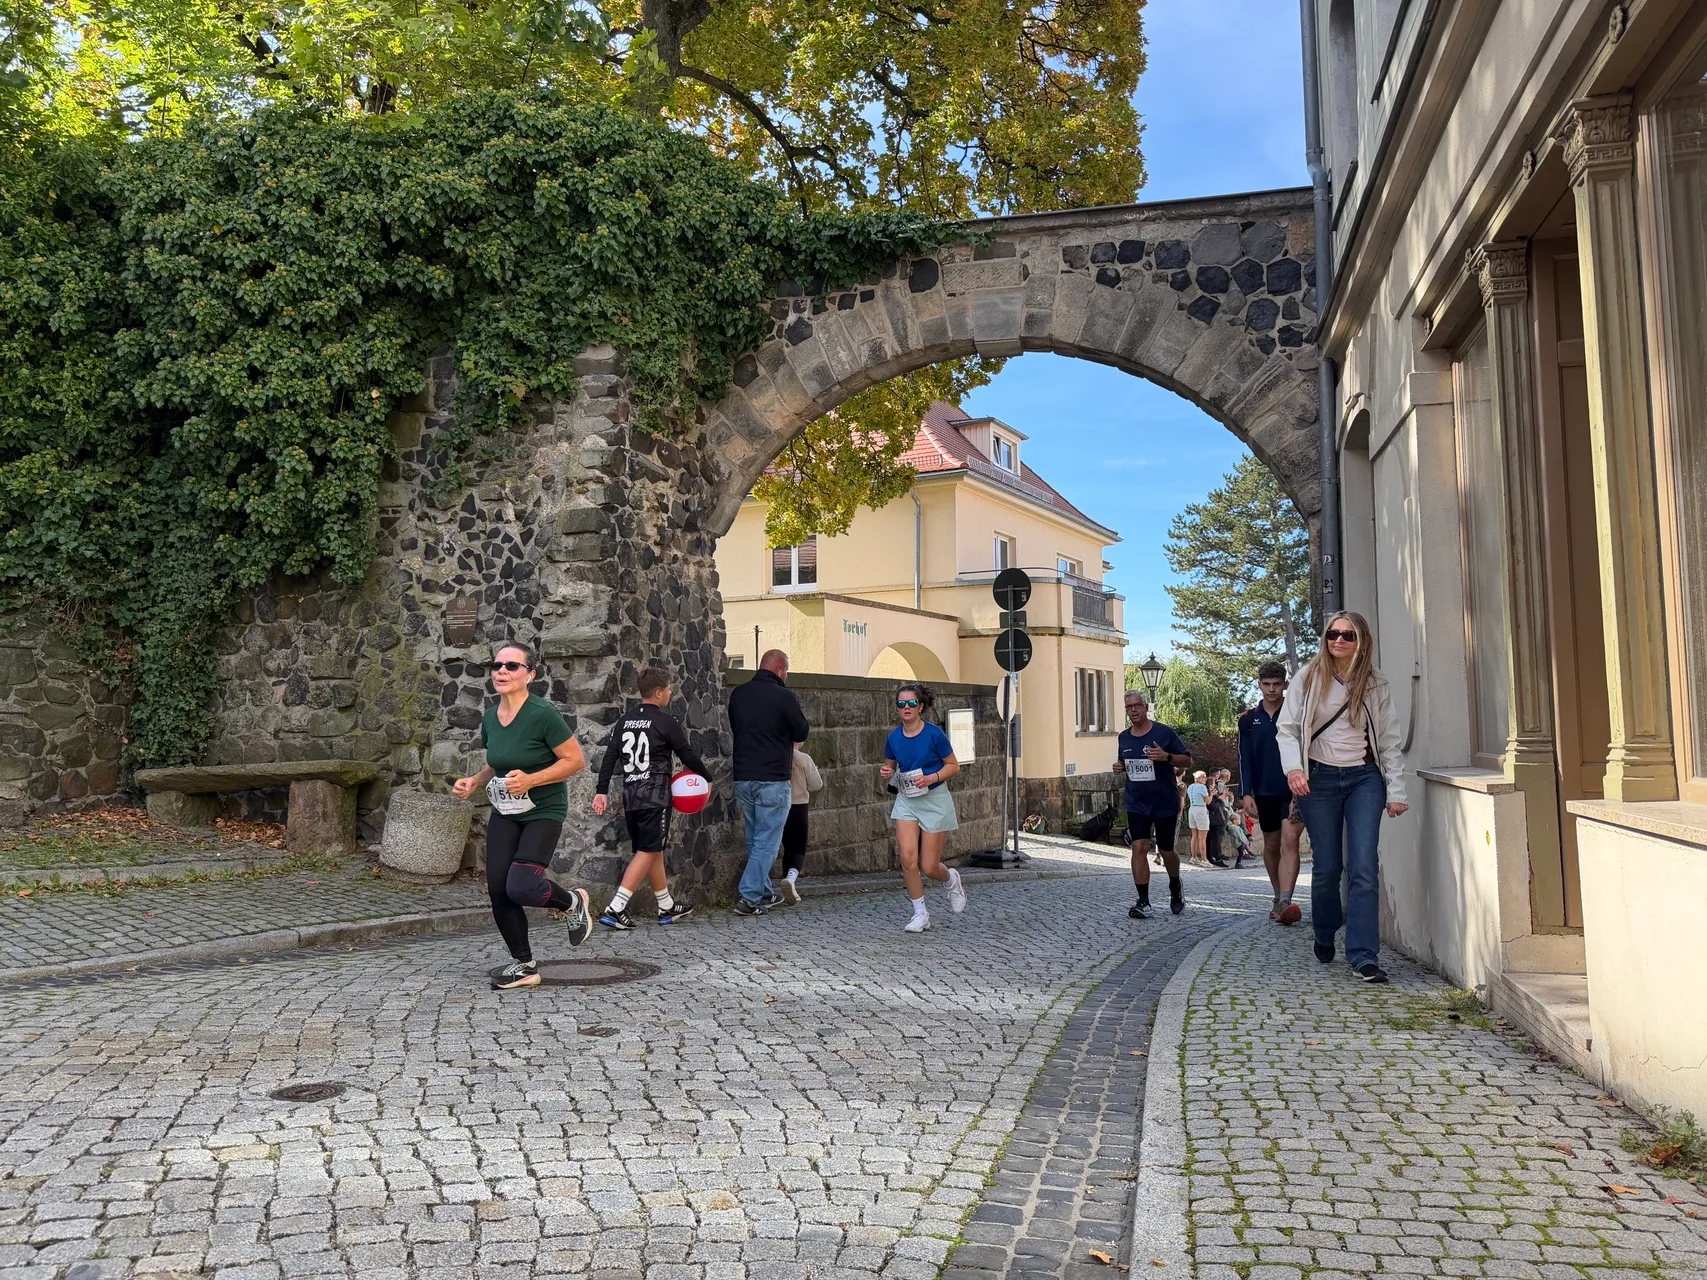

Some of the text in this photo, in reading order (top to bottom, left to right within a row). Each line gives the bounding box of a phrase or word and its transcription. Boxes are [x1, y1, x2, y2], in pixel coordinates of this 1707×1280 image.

[623, 720, 652, 729] DRESDEN
[622, 731, 650, 773] 30
[486, 786, 493, 798] 6
